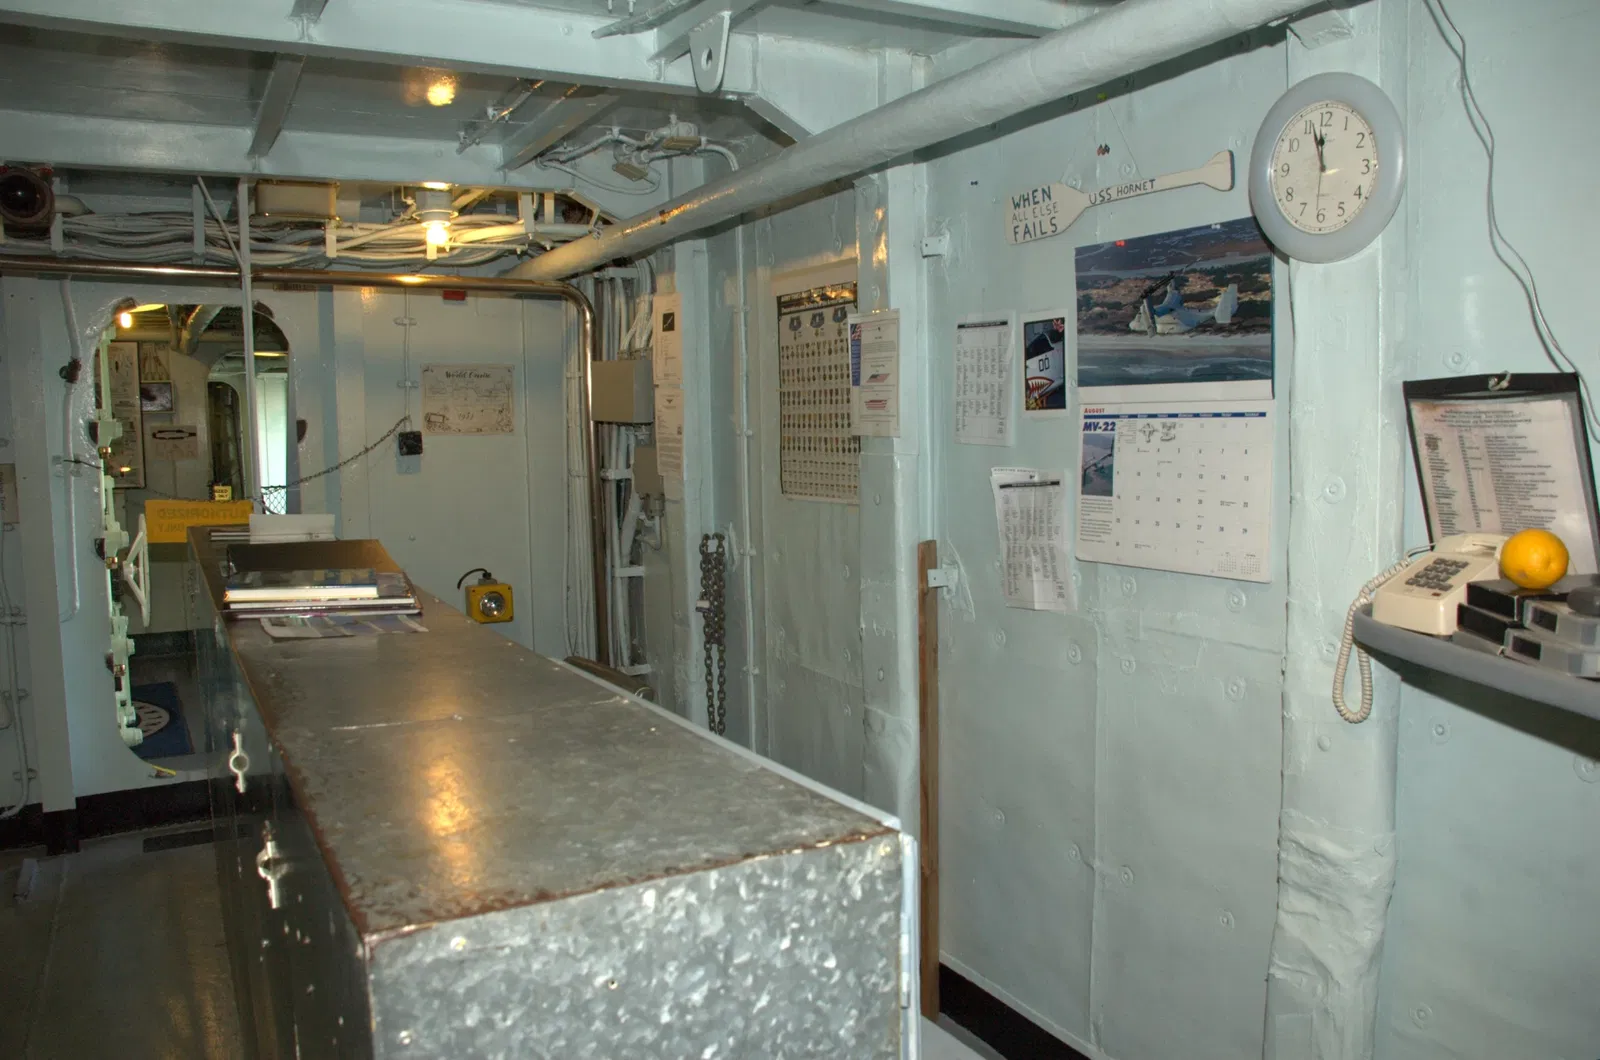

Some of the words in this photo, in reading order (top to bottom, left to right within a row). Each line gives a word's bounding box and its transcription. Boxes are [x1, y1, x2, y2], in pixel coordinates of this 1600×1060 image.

[1319, 111, 1333, 127] 12
[1344, 116, 1349, 131] 1
[1303, 120, 1312, 135] 11
[1288, 137, 1300, 153] 10
[1356, 132, 1365, 149] 2
[1280, 163, 1290, 178] 9
[1361, 159, 1370, 175] 3
[1011, 185, 1052, 211] WHEN
[1088, 188, 1112, 205] USS
[1116, 178, 1156, 198] HORNET
[1285, 186, 1294, 202] 8
[1353, 184, 1362, 200] 4
[1011, 210, 1028, 224] ALL
[1032, 201, 1060, 220] ELSE
[1299, 202, 1307, 217] 7
[1316, 208, 1325, 223] 6
[1337, 201, 1345, 217] 5
[1013, 216, 1058, 244] FAILS
[1082, 421, 1117, 432] MV-22
